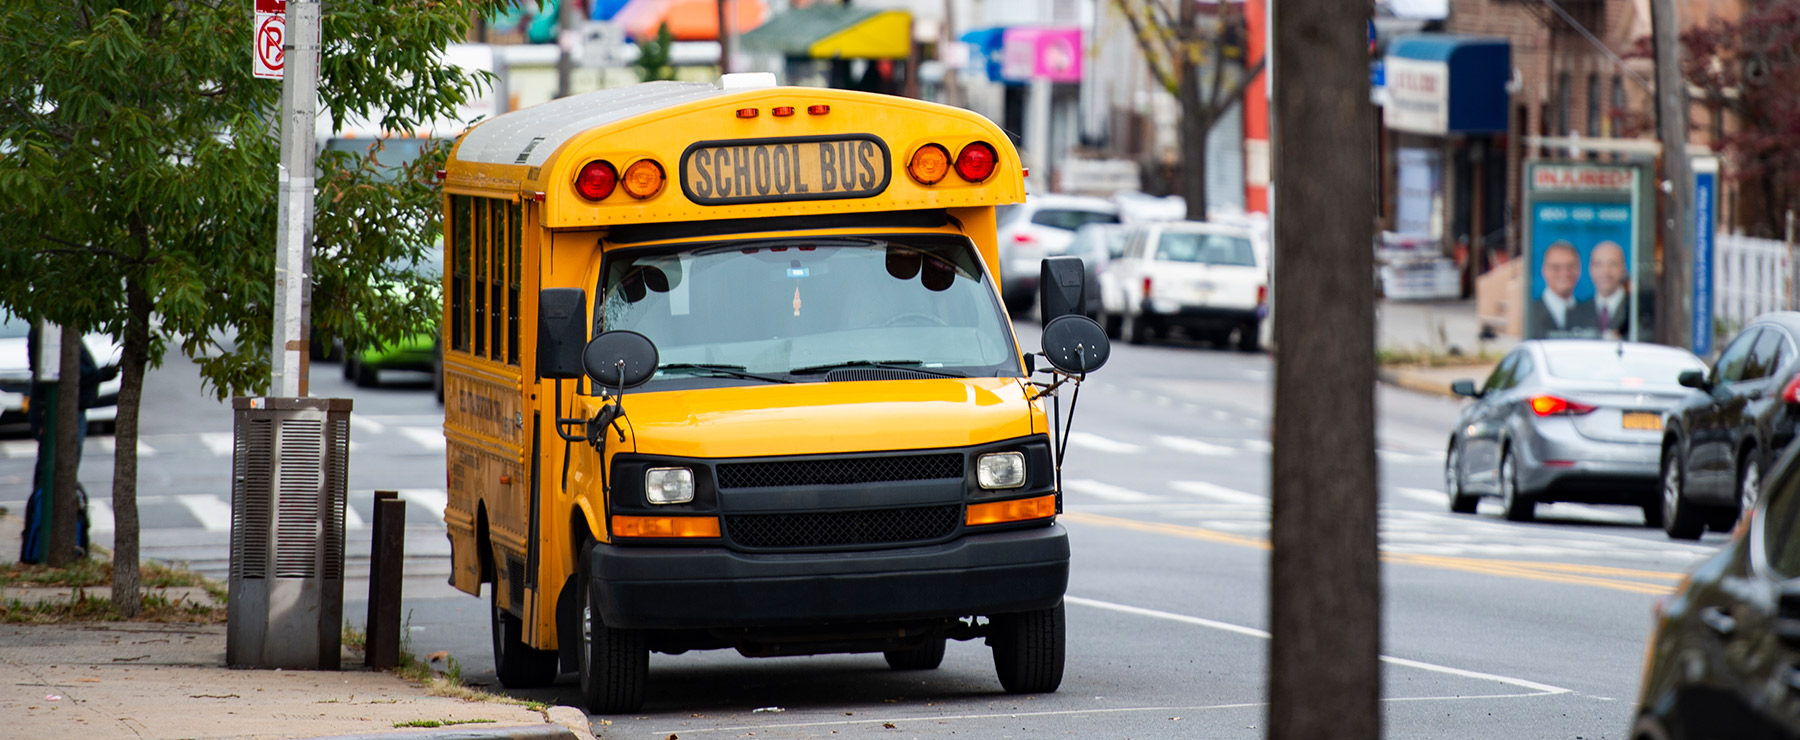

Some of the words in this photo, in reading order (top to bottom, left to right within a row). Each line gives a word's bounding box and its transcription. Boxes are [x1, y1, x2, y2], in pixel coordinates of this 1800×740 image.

[695, 144, 809, 199] SCHOOL
[819, 140, 876, 192] BUS
[1536, 167, 1634, 188] INJURED?
